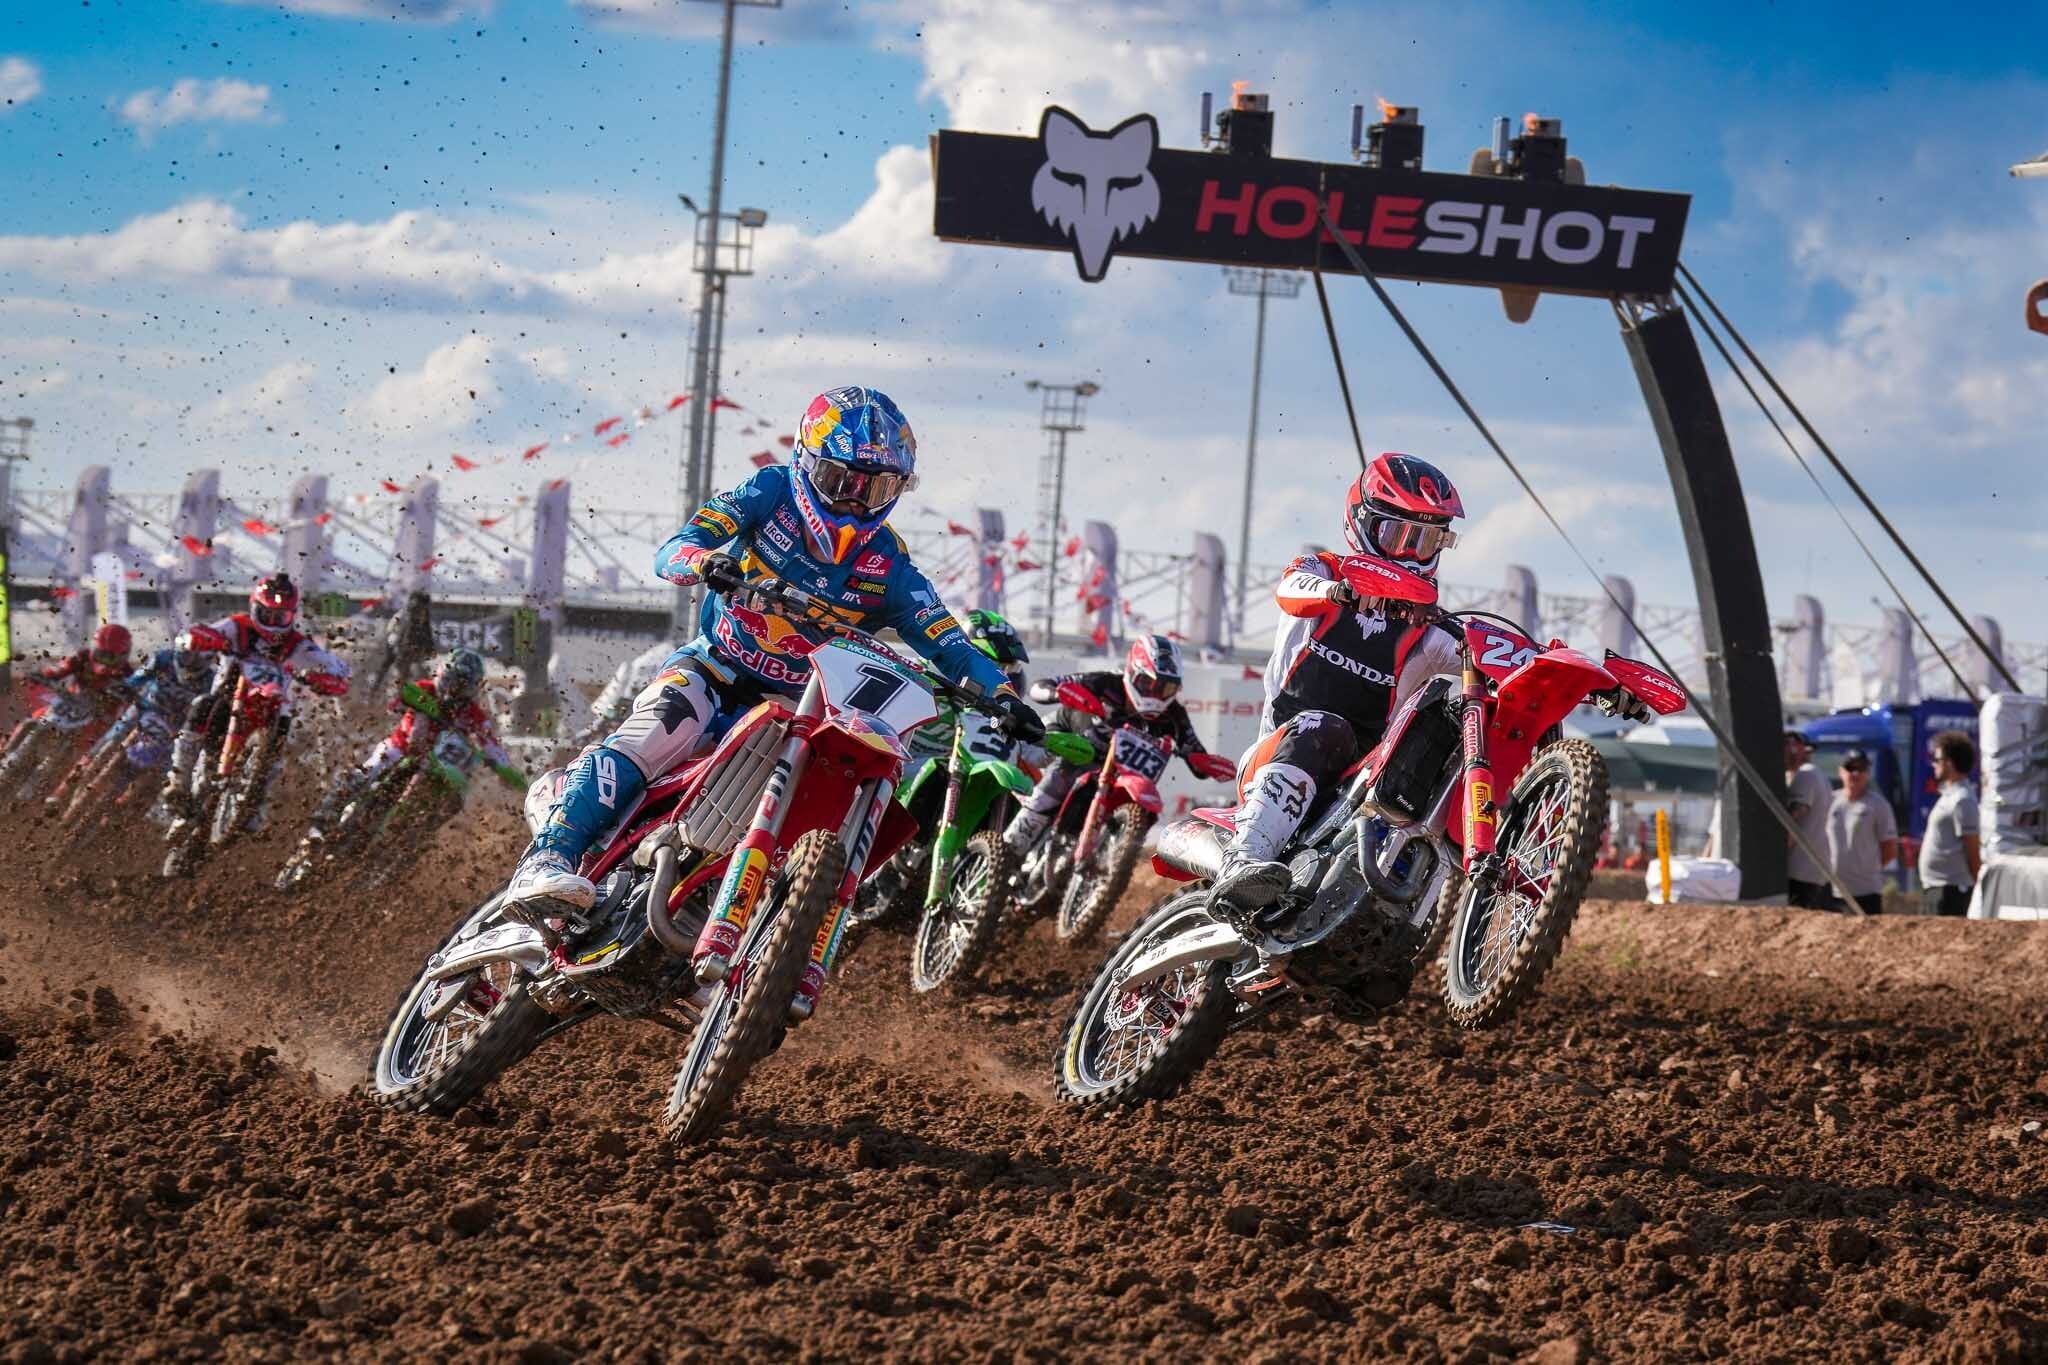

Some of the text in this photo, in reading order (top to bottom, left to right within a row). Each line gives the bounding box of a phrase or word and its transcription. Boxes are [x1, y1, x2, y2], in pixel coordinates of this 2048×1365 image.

[1195, 179, 1656, 269] HOLESHOT
[1418, 513, 1433, 521] FOX
[1347, 559, 1401, 582] ACERBIS
[716, 614, 812, 685] Red Bul
[847, 643, 898, 670] MOTOREX
[1309, 637, 1397, 687] HONDA
[843, 663, 908, 716] 1
[1641, 674, 1687, 700] ACERBIS
[1113, 740, 1164, 781] 303
